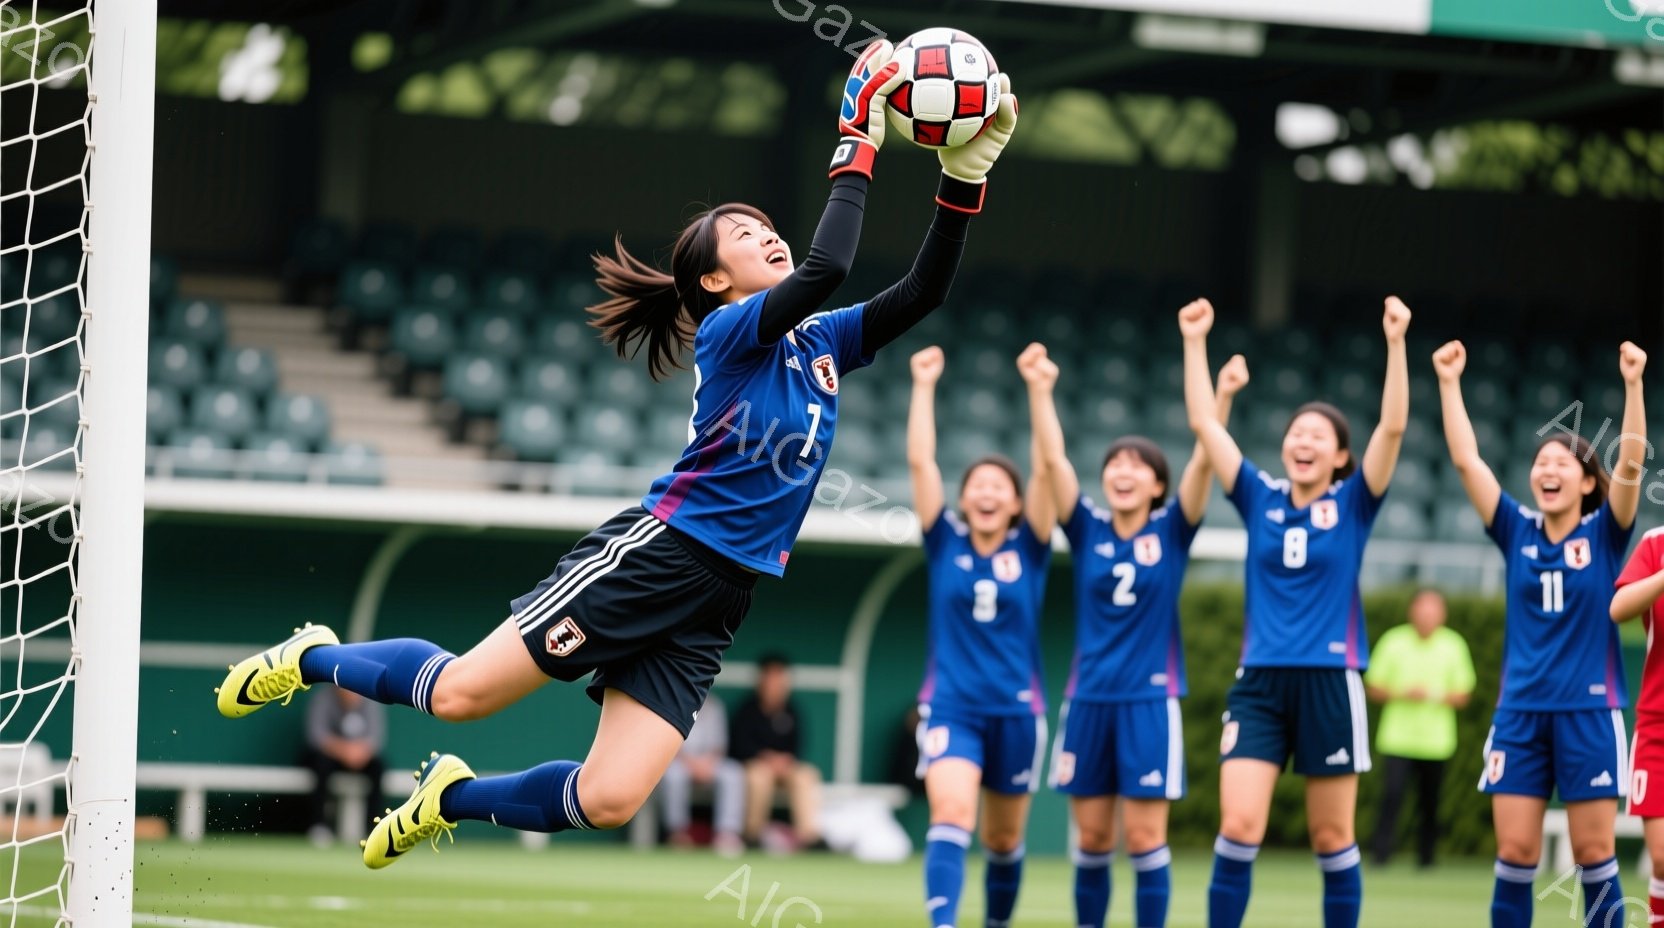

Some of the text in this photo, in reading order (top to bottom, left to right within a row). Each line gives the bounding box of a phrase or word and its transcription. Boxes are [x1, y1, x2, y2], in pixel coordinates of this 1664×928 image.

[1283, 527, 1308, 569] 8
[972, 579, 998, 623] 3
[1112, 562, 1137, 606] 2
[1540, 570, 1564, 613] 11
